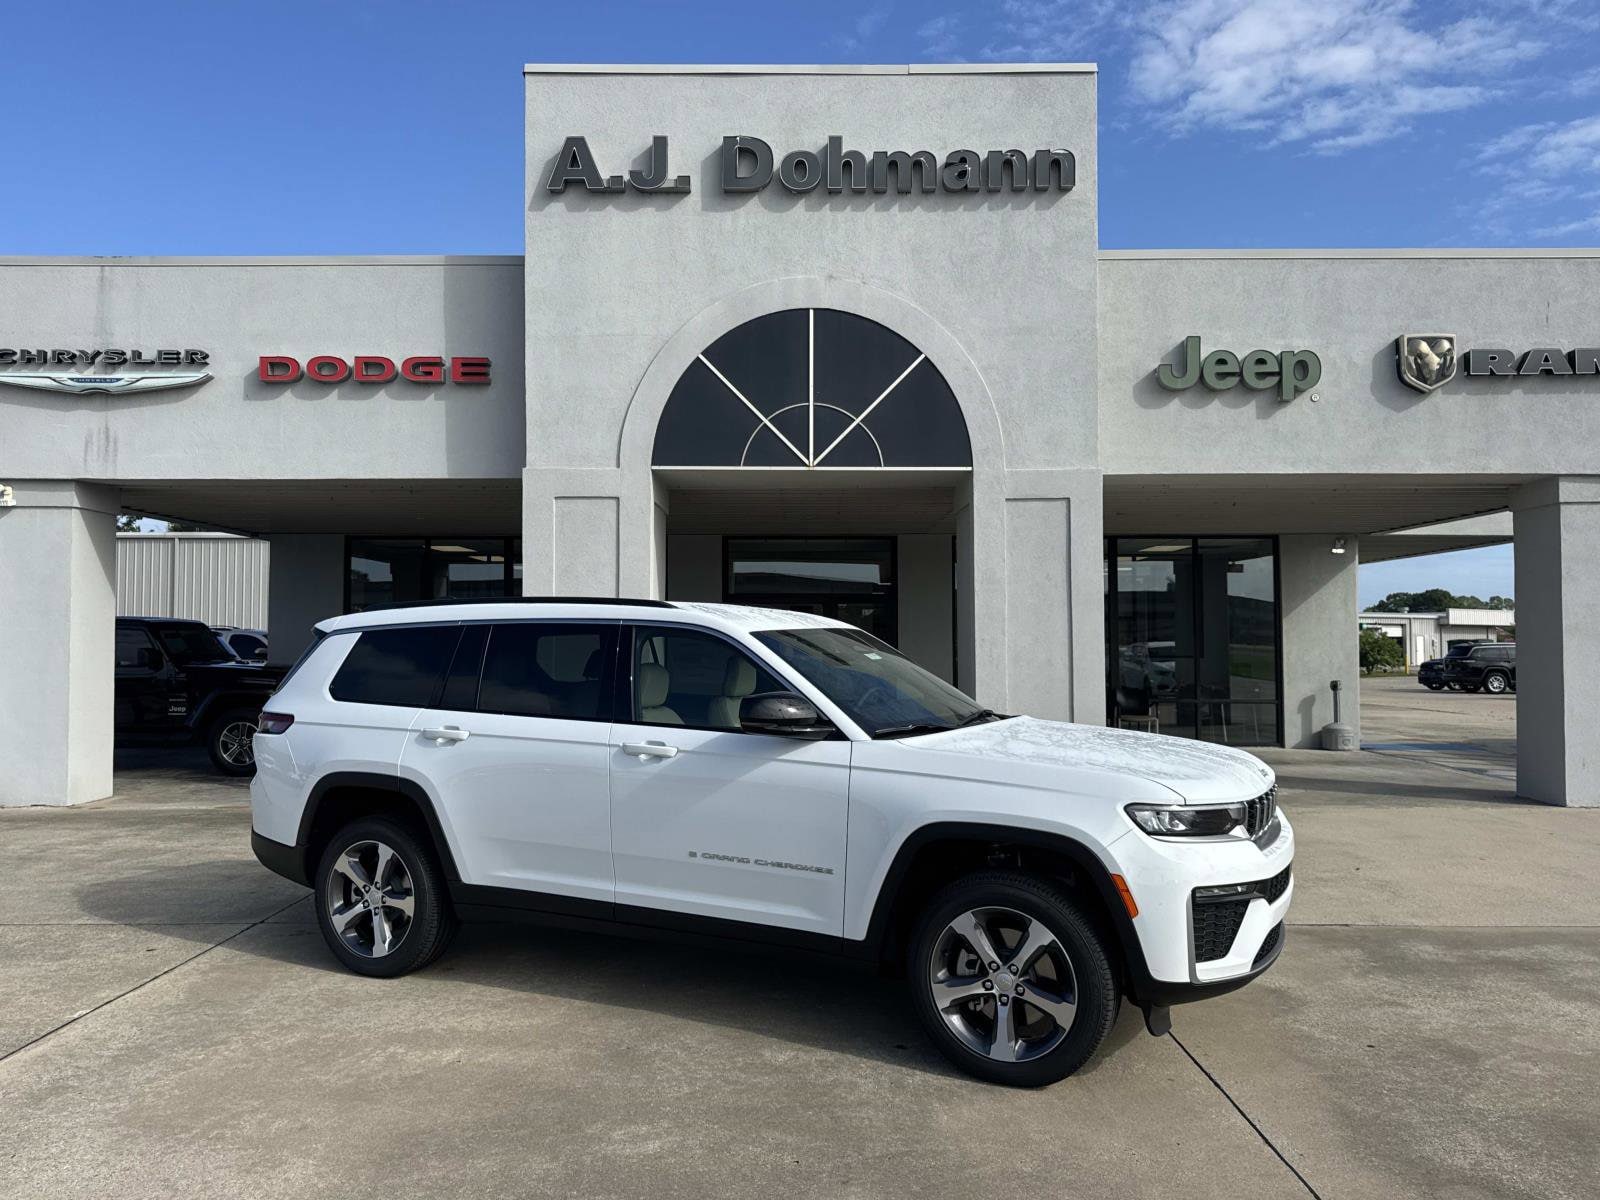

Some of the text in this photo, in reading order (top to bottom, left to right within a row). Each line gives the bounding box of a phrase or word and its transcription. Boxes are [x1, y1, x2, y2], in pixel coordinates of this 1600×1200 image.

[547, 135, 1076, 193] A.J. Dohmann
[0, 349, 210, 364] CHRYSLER
[259, 356, 491, 384] DODGE
[1158, 336, 1321, 400] Jeep
[701, 853, 750, 864] GRAND
